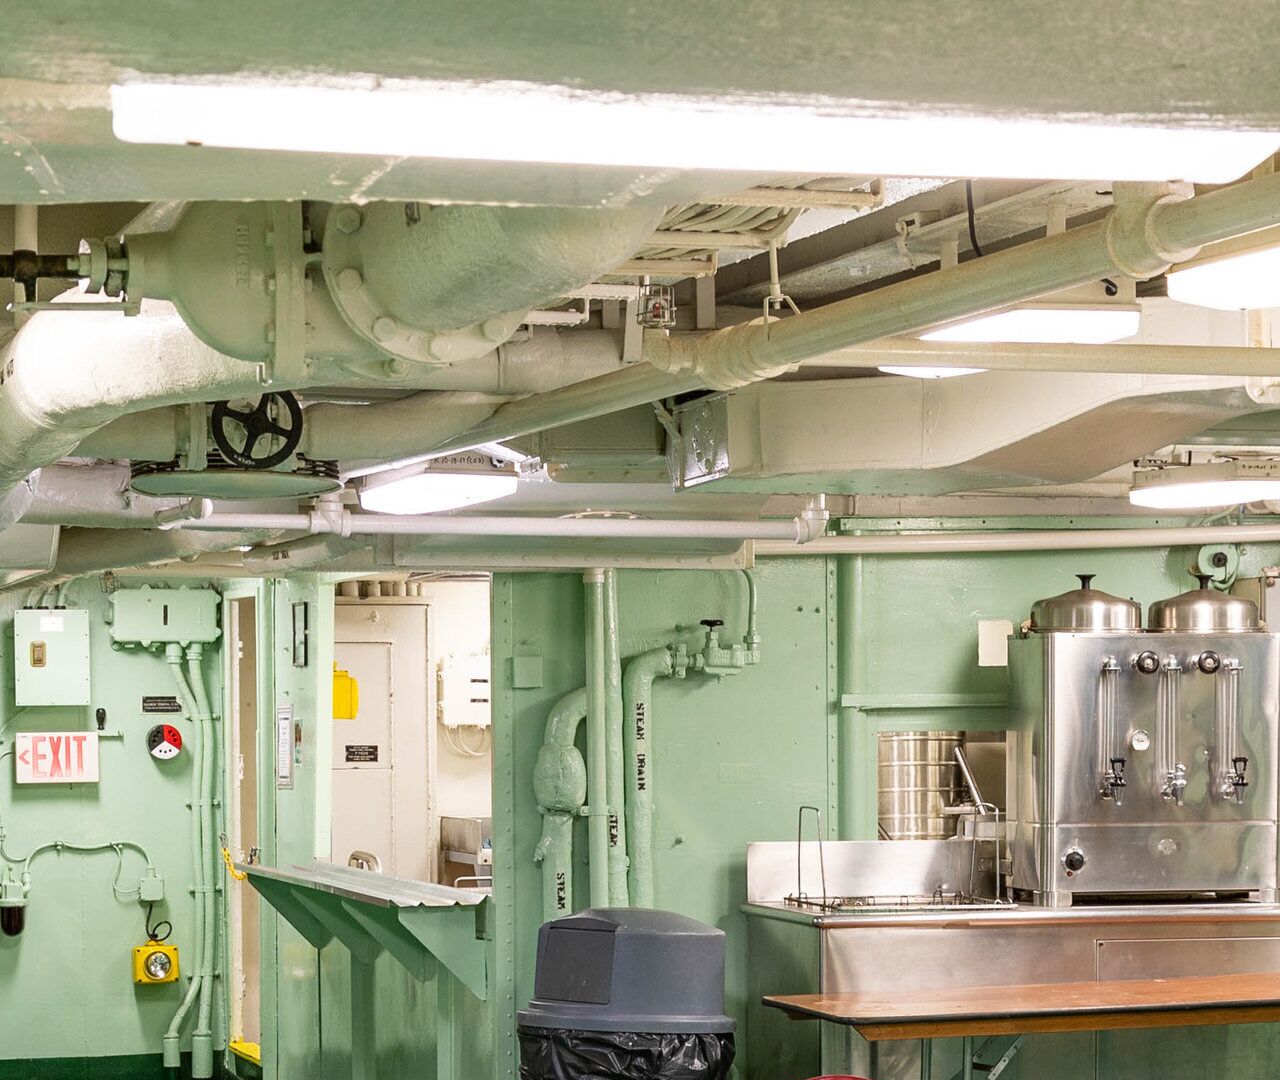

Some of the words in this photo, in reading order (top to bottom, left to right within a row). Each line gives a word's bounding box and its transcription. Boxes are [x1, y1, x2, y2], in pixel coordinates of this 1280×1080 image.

[636, 703, 645, 740] STEAM
[31, 735, 87, 778] EXIT
[637, 753, 646, 791] DRAIN
[556, 872, 566, 910] STEAM
